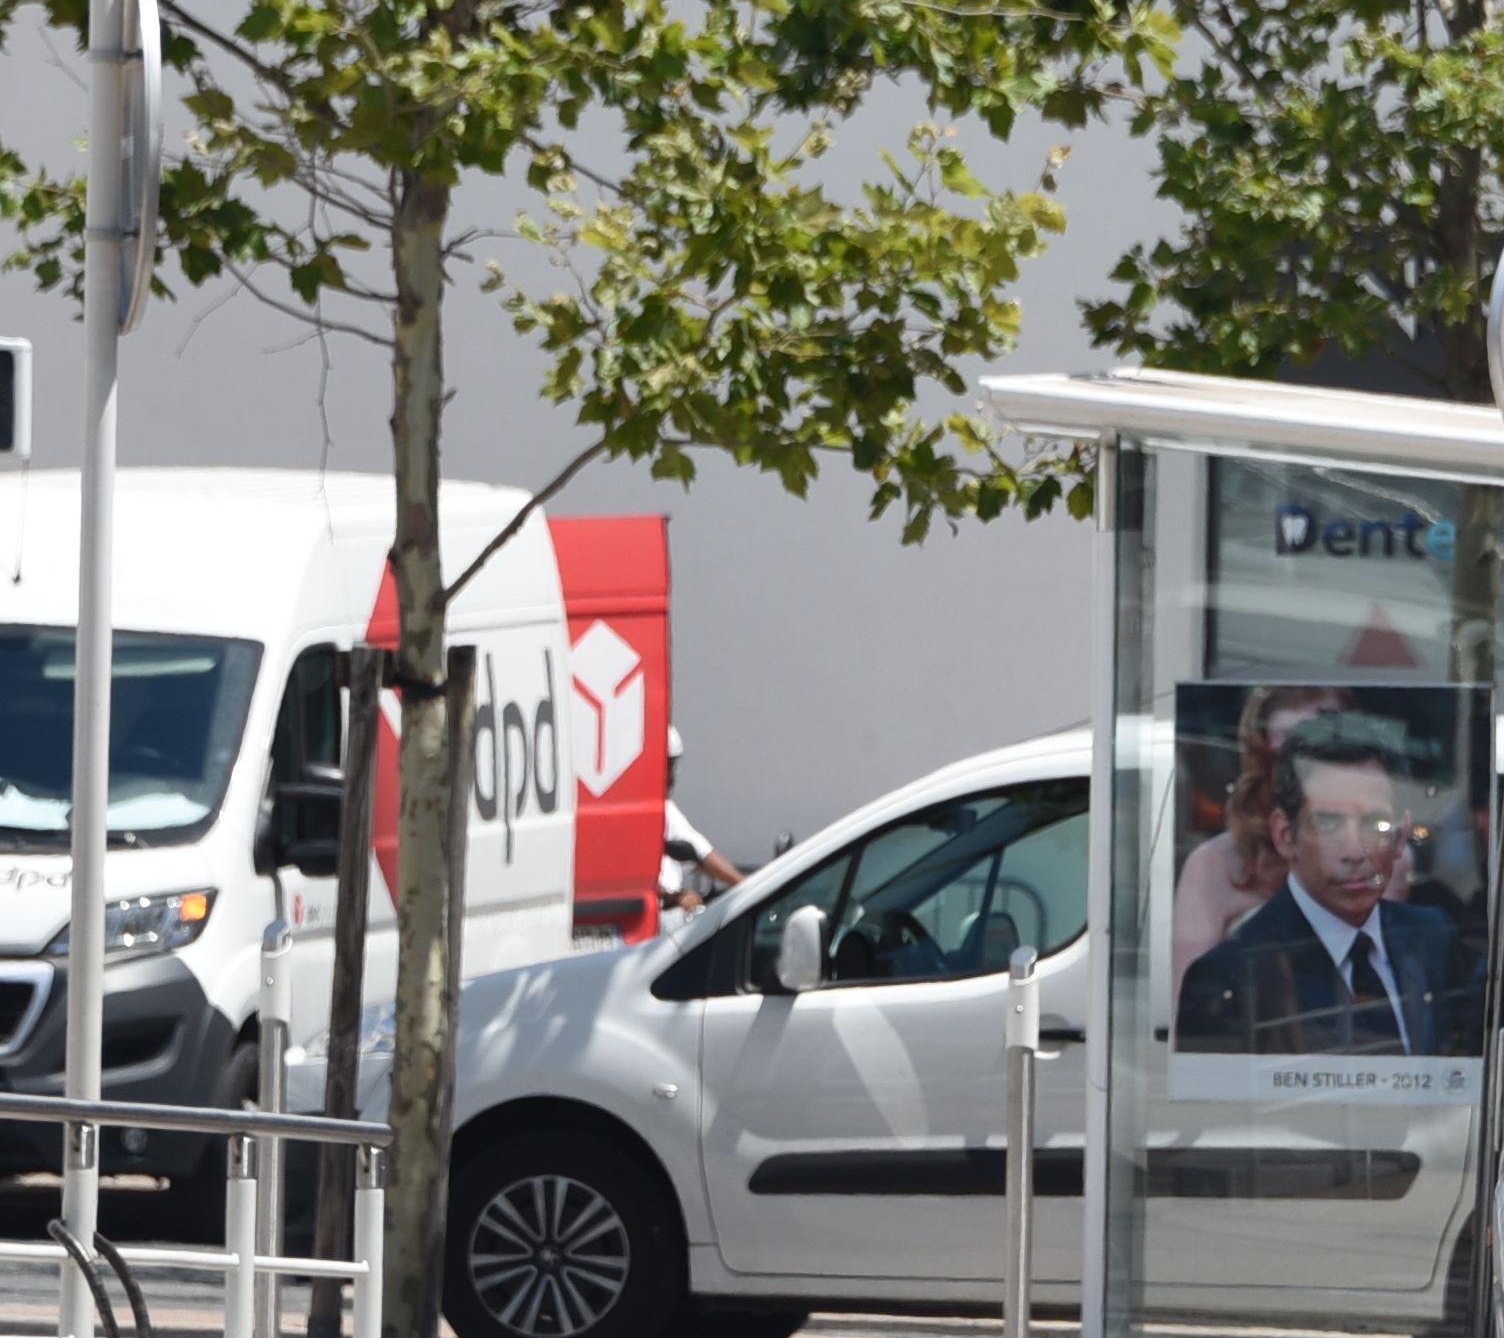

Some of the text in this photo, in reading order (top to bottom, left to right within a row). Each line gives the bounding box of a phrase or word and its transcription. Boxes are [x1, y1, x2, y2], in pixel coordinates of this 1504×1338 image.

[474, 647, 559, 867] dpd
[1272, 1071, 1308, 1088] BEN
[1312, 1071, 1377, 1089] STILLER
[1391, 1073, 1433, 1090] 2012
